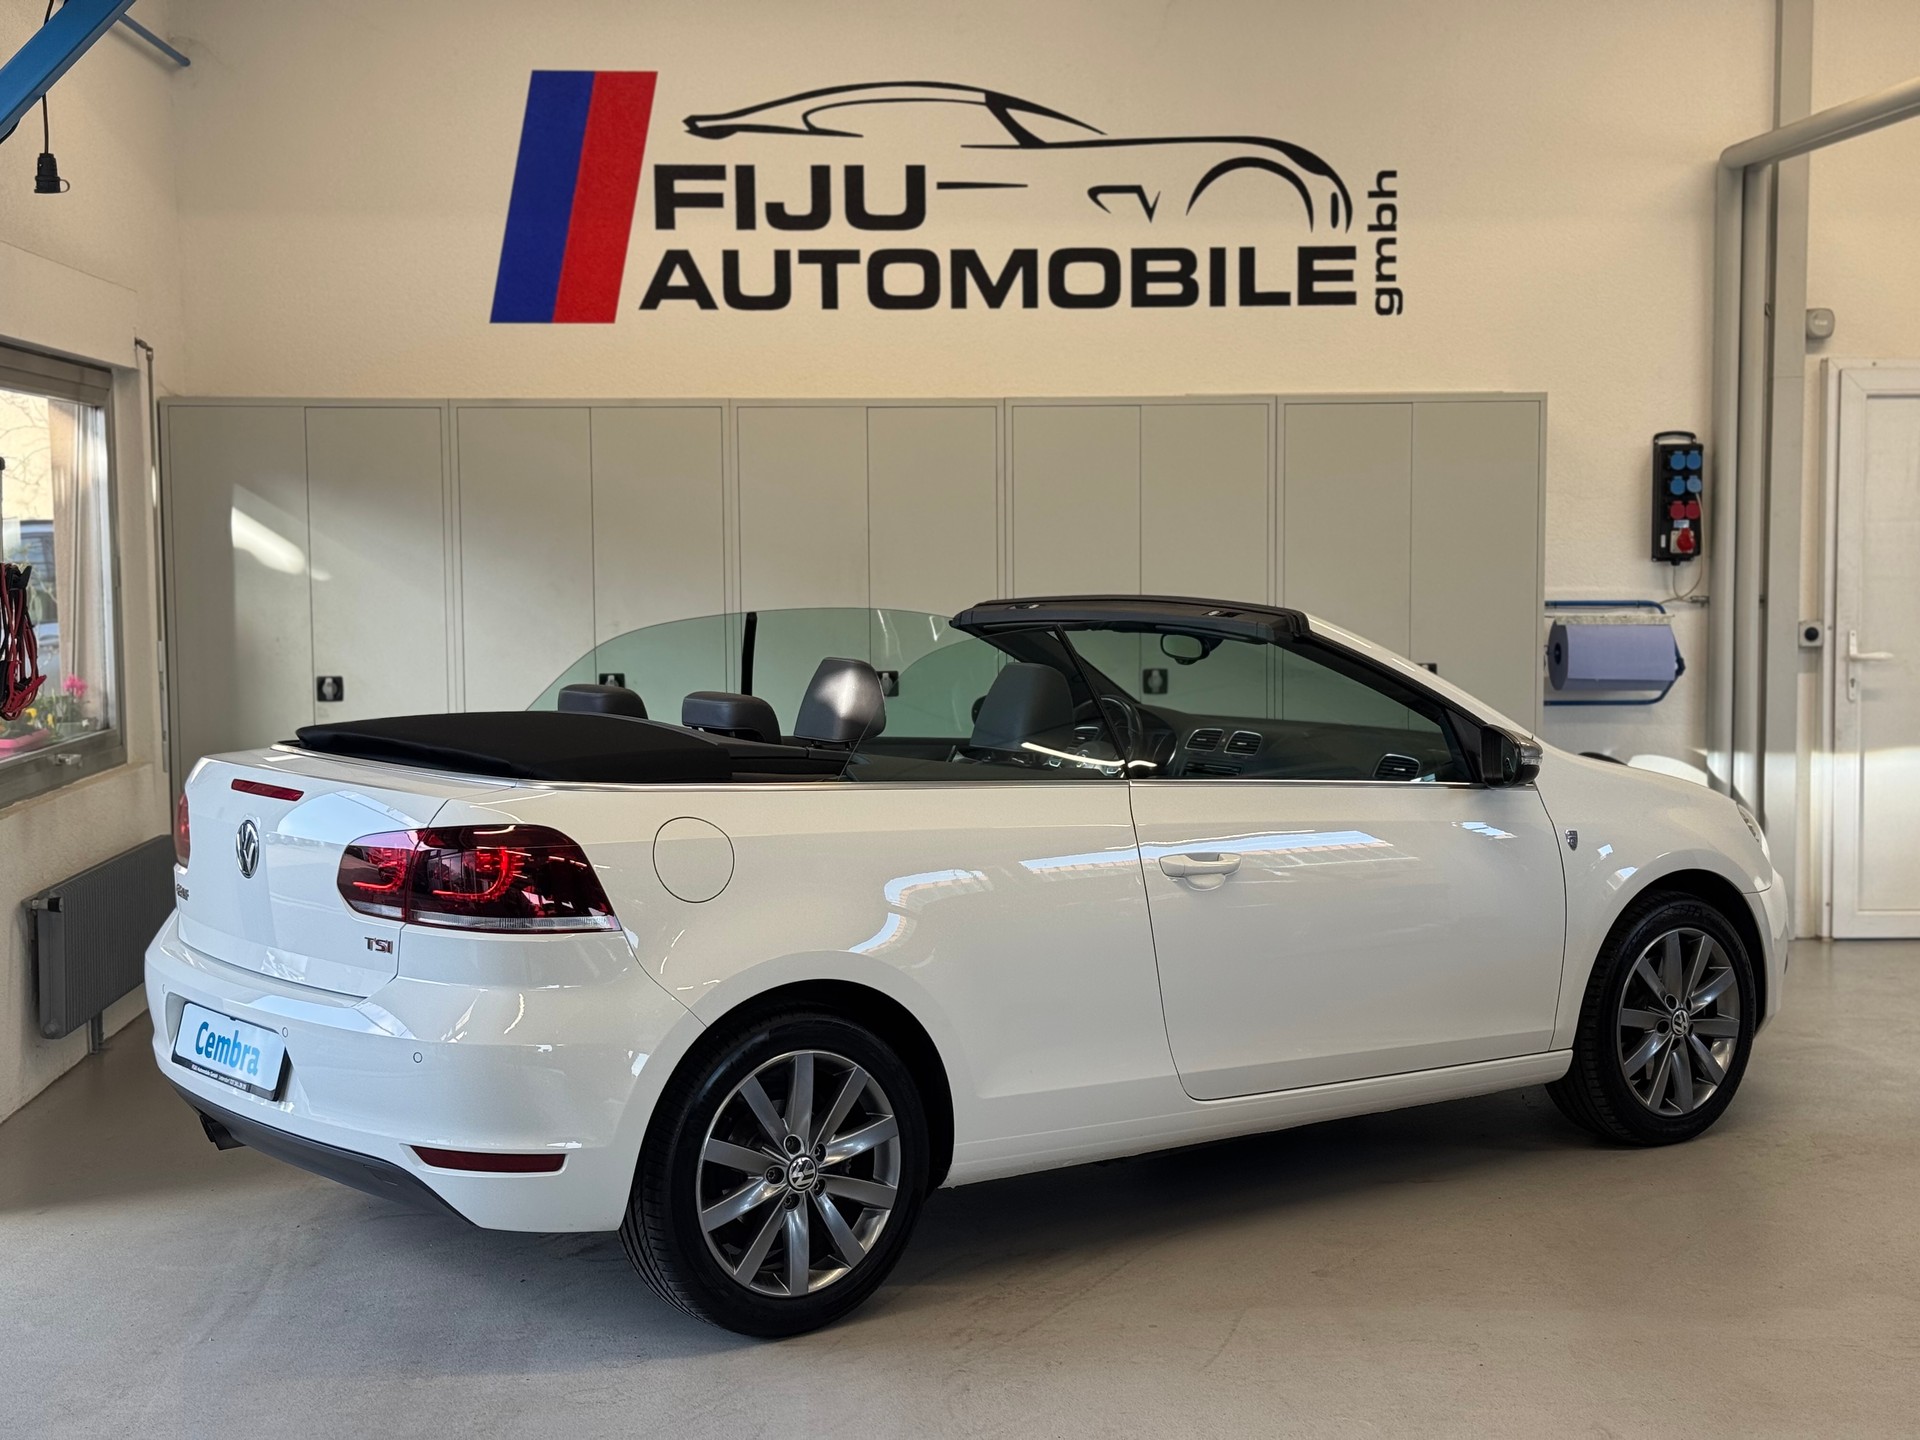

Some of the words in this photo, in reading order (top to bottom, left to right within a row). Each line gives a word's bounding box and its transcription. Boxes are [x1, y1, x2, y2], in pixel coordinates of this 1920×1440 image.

[655, 165, 926, 230] FIJU
[1367, 170, 1402, 315] gmbh
[640, 246, 1357, 310] AUTOMOBILE
[364, 936, 394, 955] TSI
[195, 1021, 260, 1076] Cembra
